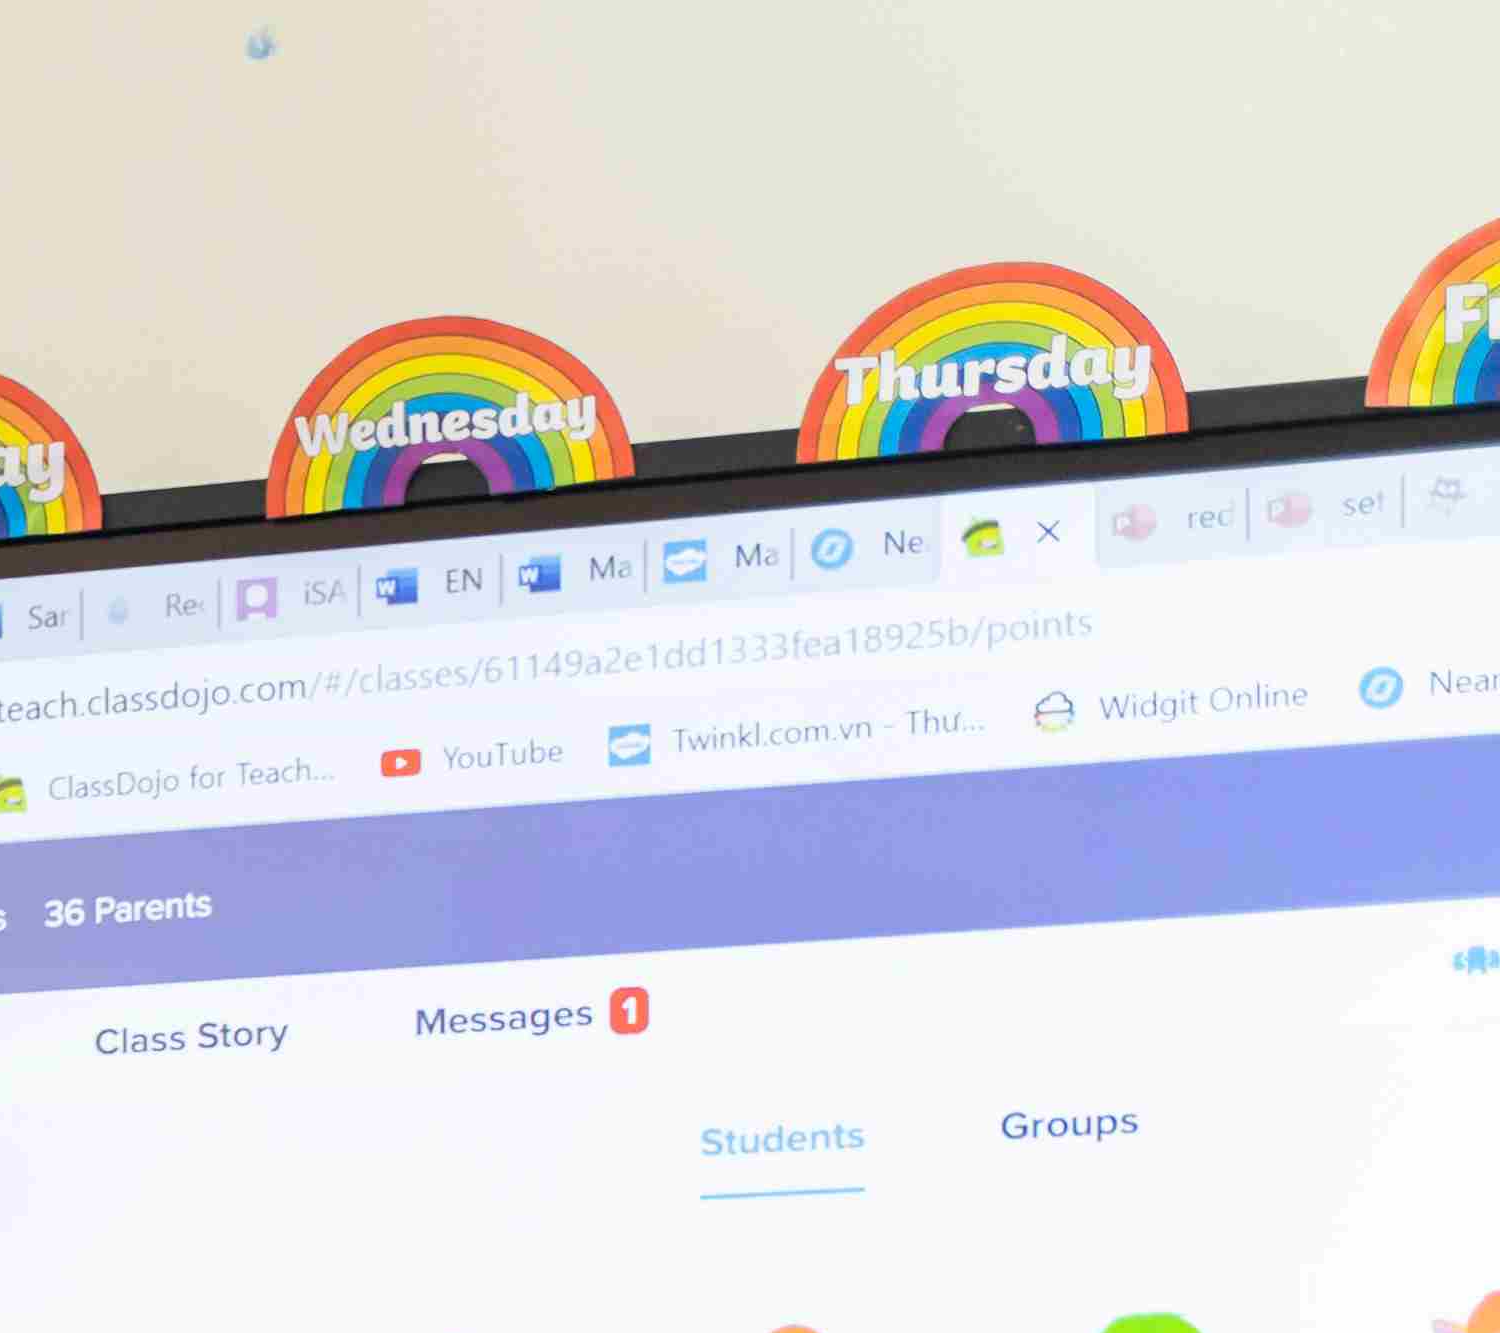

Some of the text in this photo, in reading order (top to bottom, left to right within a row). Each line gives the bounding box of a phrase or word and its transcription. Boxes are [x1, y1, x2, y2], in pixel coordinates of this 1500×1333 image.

[834, 333, 1153, 406] Thursday
[293, 388, 598, 458] Wednesday
[446, 567, 483, 594] EN
[1101, 682, 1310, 724] Widgit Online
[675, 717, 874, 754] Twinkl.com.vn
[444, 740, 565, 772] YouTube
[49, 757, 335, 802] ClassDojo for Teach...
[44, 890, 213, 929] 36 Parents
[415, 1000, 595, 1037] Messages
[94, 1021, 290, 1056] Class Story
[700, 1120, 866, 1157] Students
[1000, 1109, 1141, 1144] Groups
